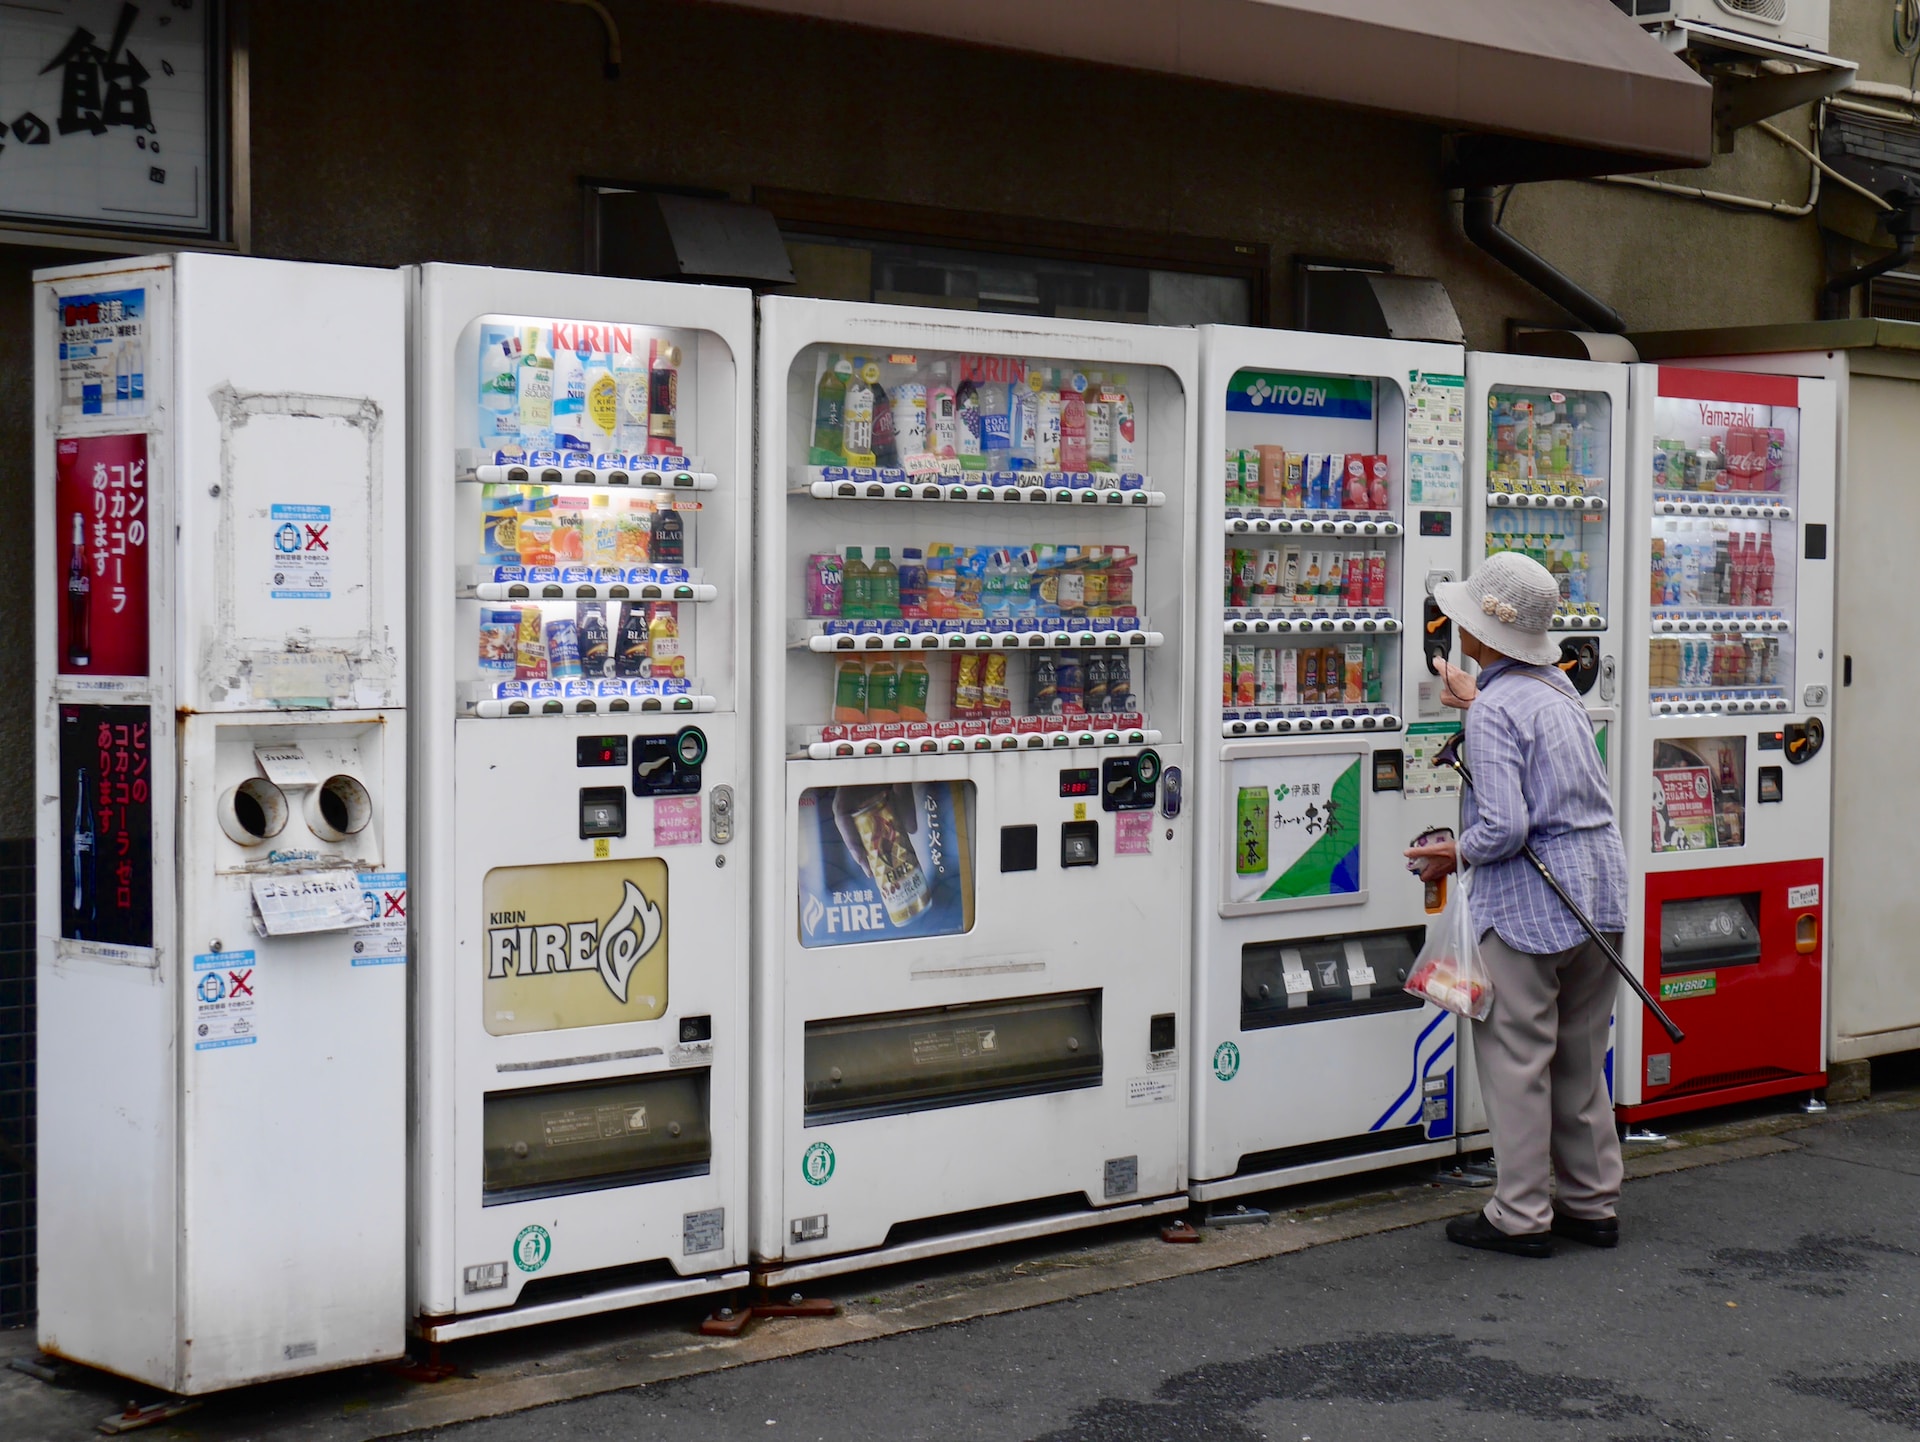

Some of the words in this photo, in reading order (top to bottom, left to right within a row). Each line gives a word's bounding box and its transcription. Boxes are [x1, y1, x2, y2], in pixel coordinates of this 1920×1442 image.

[552, 322, 633, 354] KIRIN
[960, 355, 1026, 383] KIRIN
[1270, 385, 1301, 405] ITO
[1302, 388, 1327, 407] EN
[1698, 403, 1754, 428] Yamazaki
[127, 459, 146, 546] ビンの
[92, 462, 110, 577] あります
[110, 465, 126, 613] コカ・コーラ
[97, 722, 113, 833] あります
[132, 722, 147, 803] ビンの
[115, 725, 130, 855] コカ・コーラ
[1291, 783, 1320, 797] 伊藤園
[659, 817, 697, 827] ありがとう
[659, 831, 697, 841] ございます
[924, 795, 945, 873] 心に火を。
[115, 859, 132, 909] ゼロ
[832, 889, 874, 905] 直火珈琲
[489, 910, 526, 925] KIRIN
[826, 903, 886, 934] FIRE
[488, 918, 599, 979] FIRE
